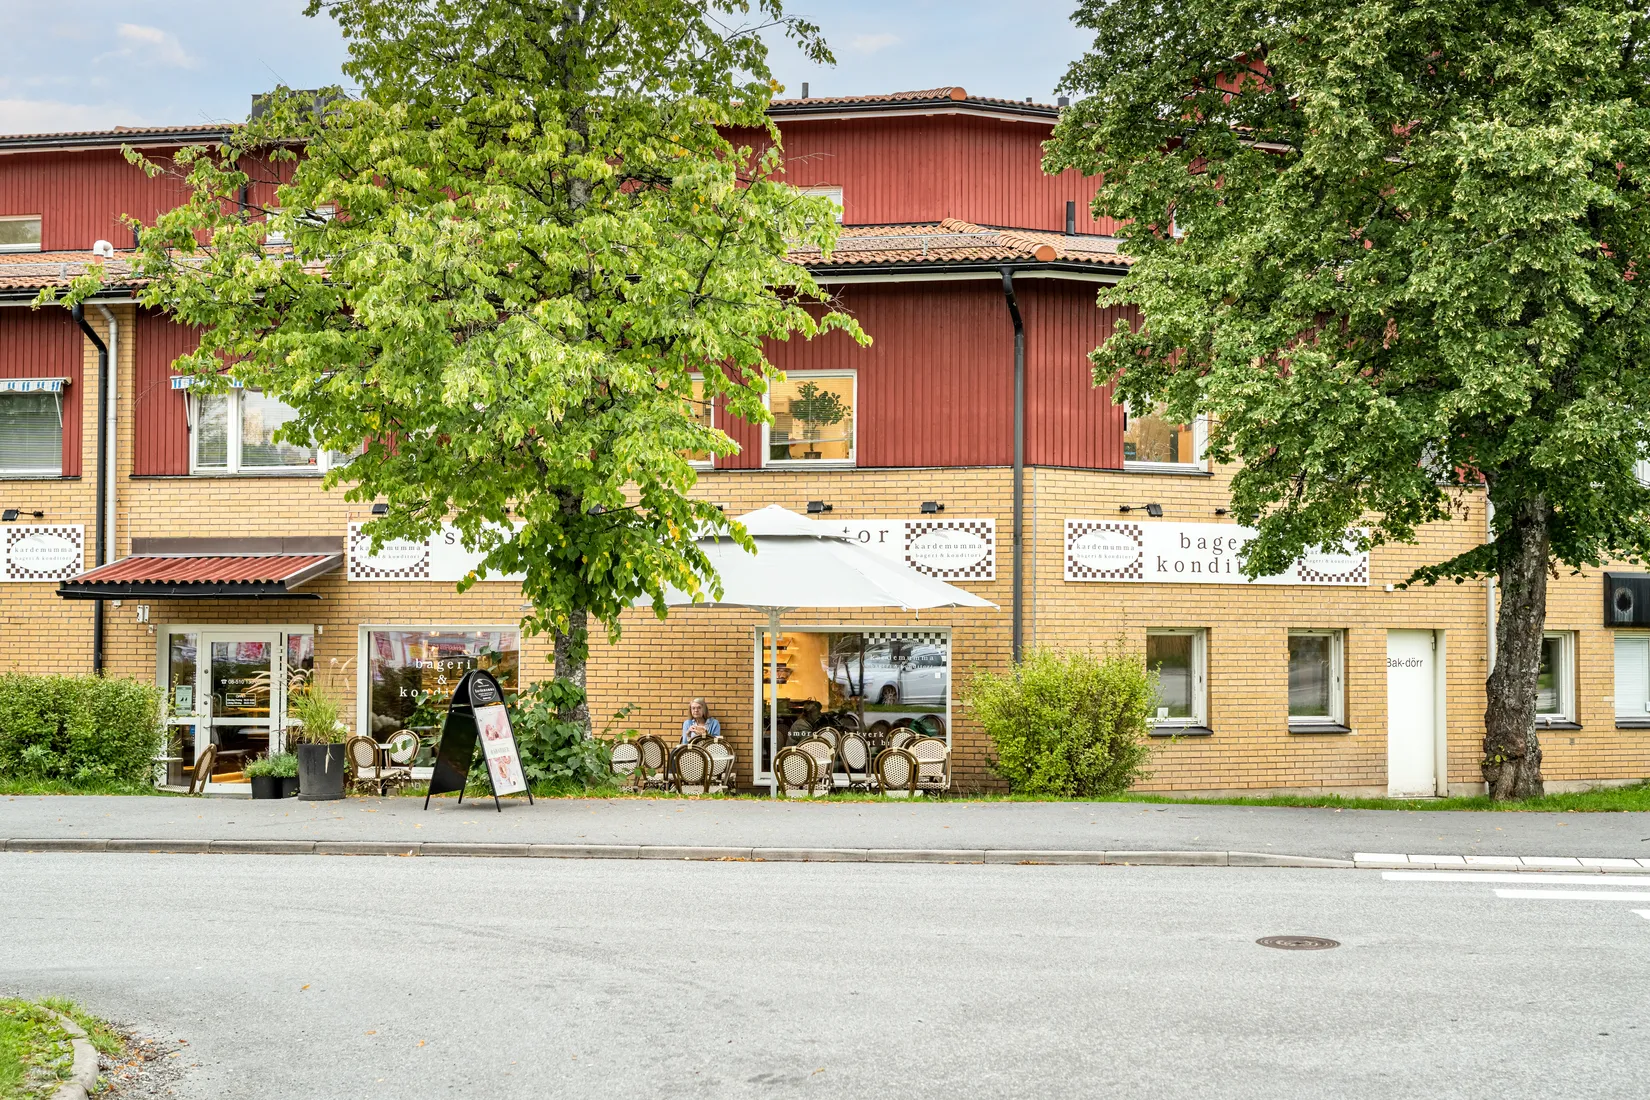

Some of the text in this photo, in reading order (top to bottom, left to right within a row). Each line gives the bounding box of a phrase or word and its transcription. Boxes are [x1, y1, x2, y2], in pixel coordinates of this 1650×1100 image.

[1076, 543, 1135, 551] kardemumma
[1180, 532, 1247, 555] bage
[1156, 555, 1243, 574] kondit
[415, 658, 471, 672] bageri
[1387, 657, 1423, 668] Bak-dörr
[437, 674, 447, 685] &
